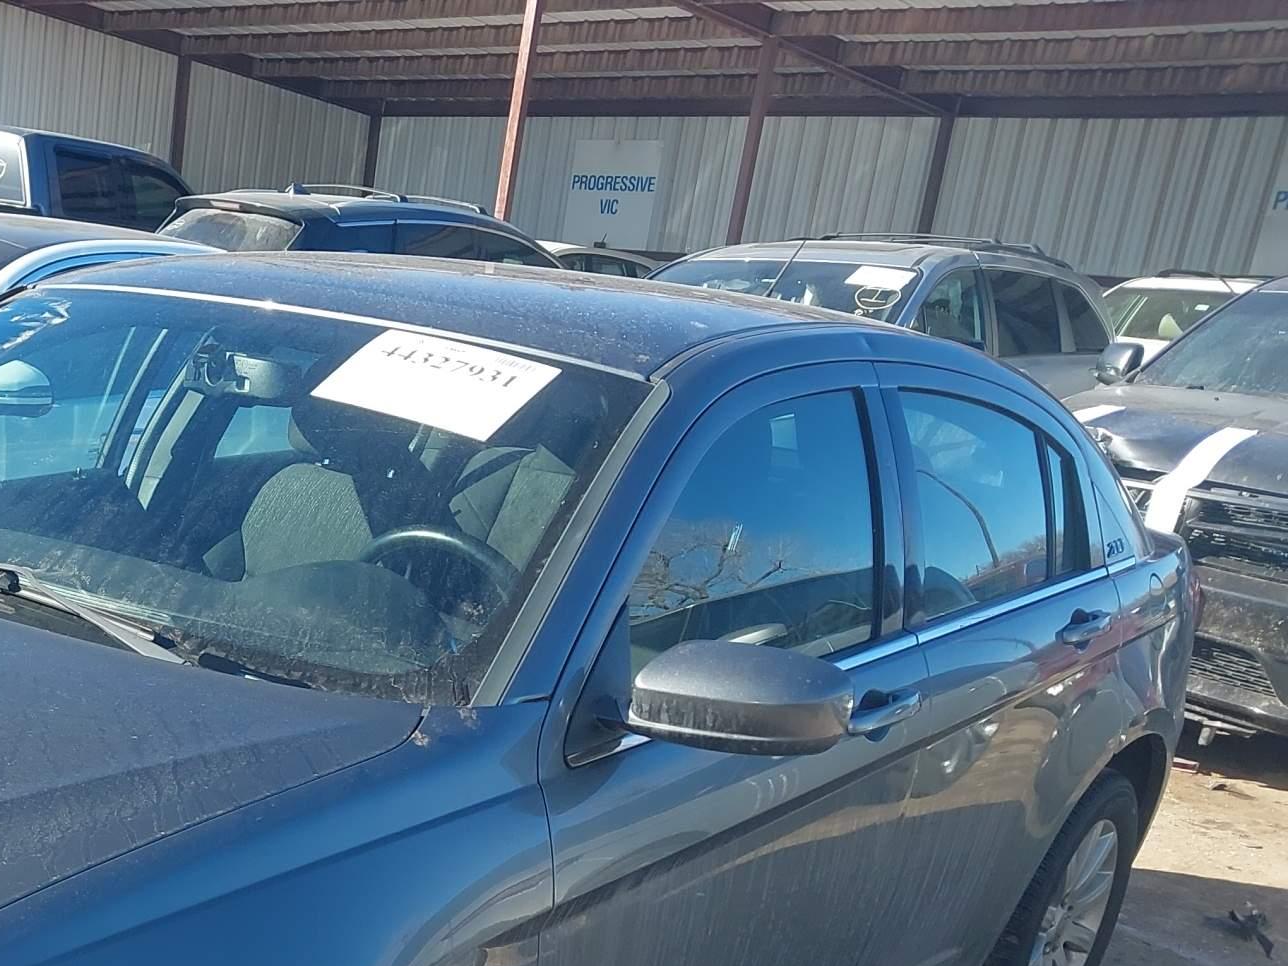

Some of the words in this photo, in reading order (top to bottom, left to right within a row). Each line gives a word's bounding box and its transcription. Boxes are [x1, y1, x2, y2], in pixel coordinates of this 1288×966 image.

[572, 175, 656, 192] PROGRESSIVE
[599, 199, 619, 215] VIC
[381, 346, 517, 387] 44327931
